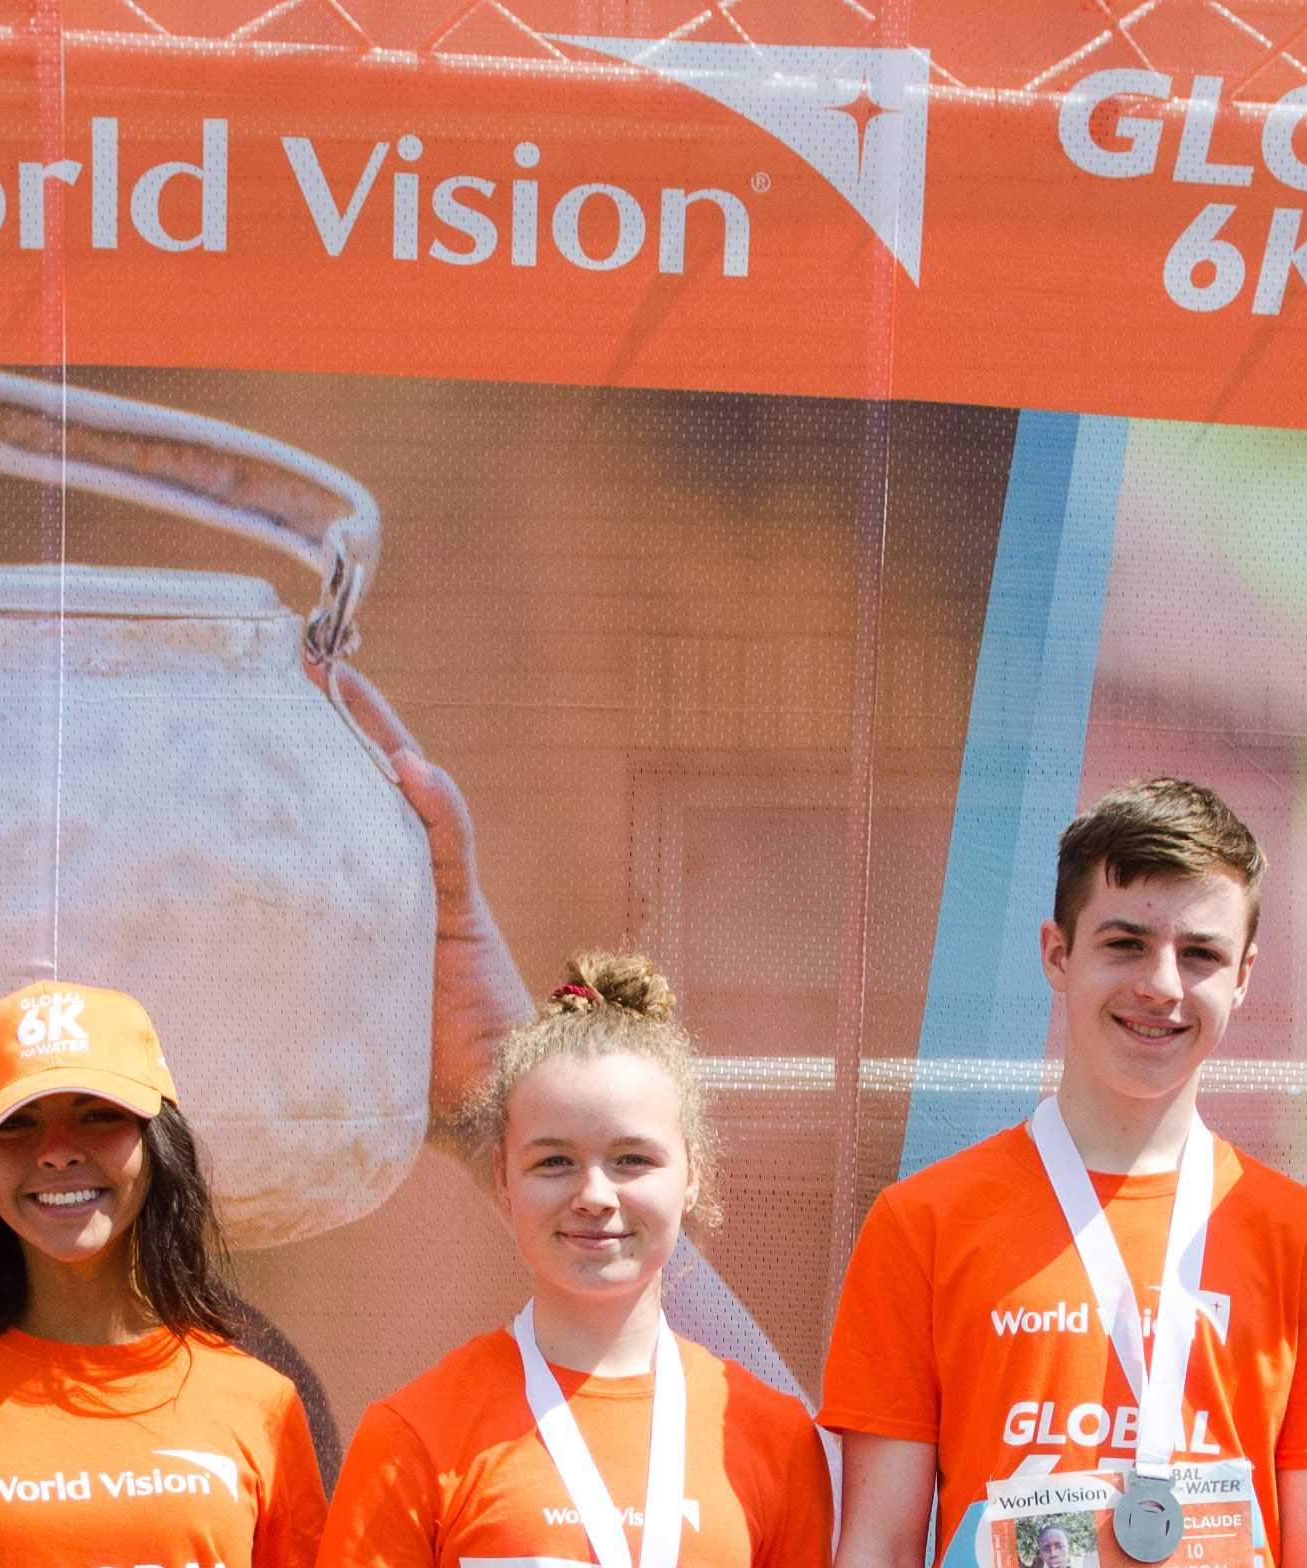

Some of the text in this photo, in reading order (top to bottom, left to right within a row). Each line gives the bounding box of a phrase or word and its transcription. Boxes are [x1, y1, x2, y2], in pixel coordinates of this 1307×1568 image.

[17, 1003, 90, 1046] 6K
[991, 1301, 1088, 1336] World
[1000, 1485, 1108, 1511] World Vision
[1186, 1480, 1241, 1495] WATER
[1183, 1513, 1242, 1530] CLAUDE
[1186, 1543, 1204, 1559] 10
